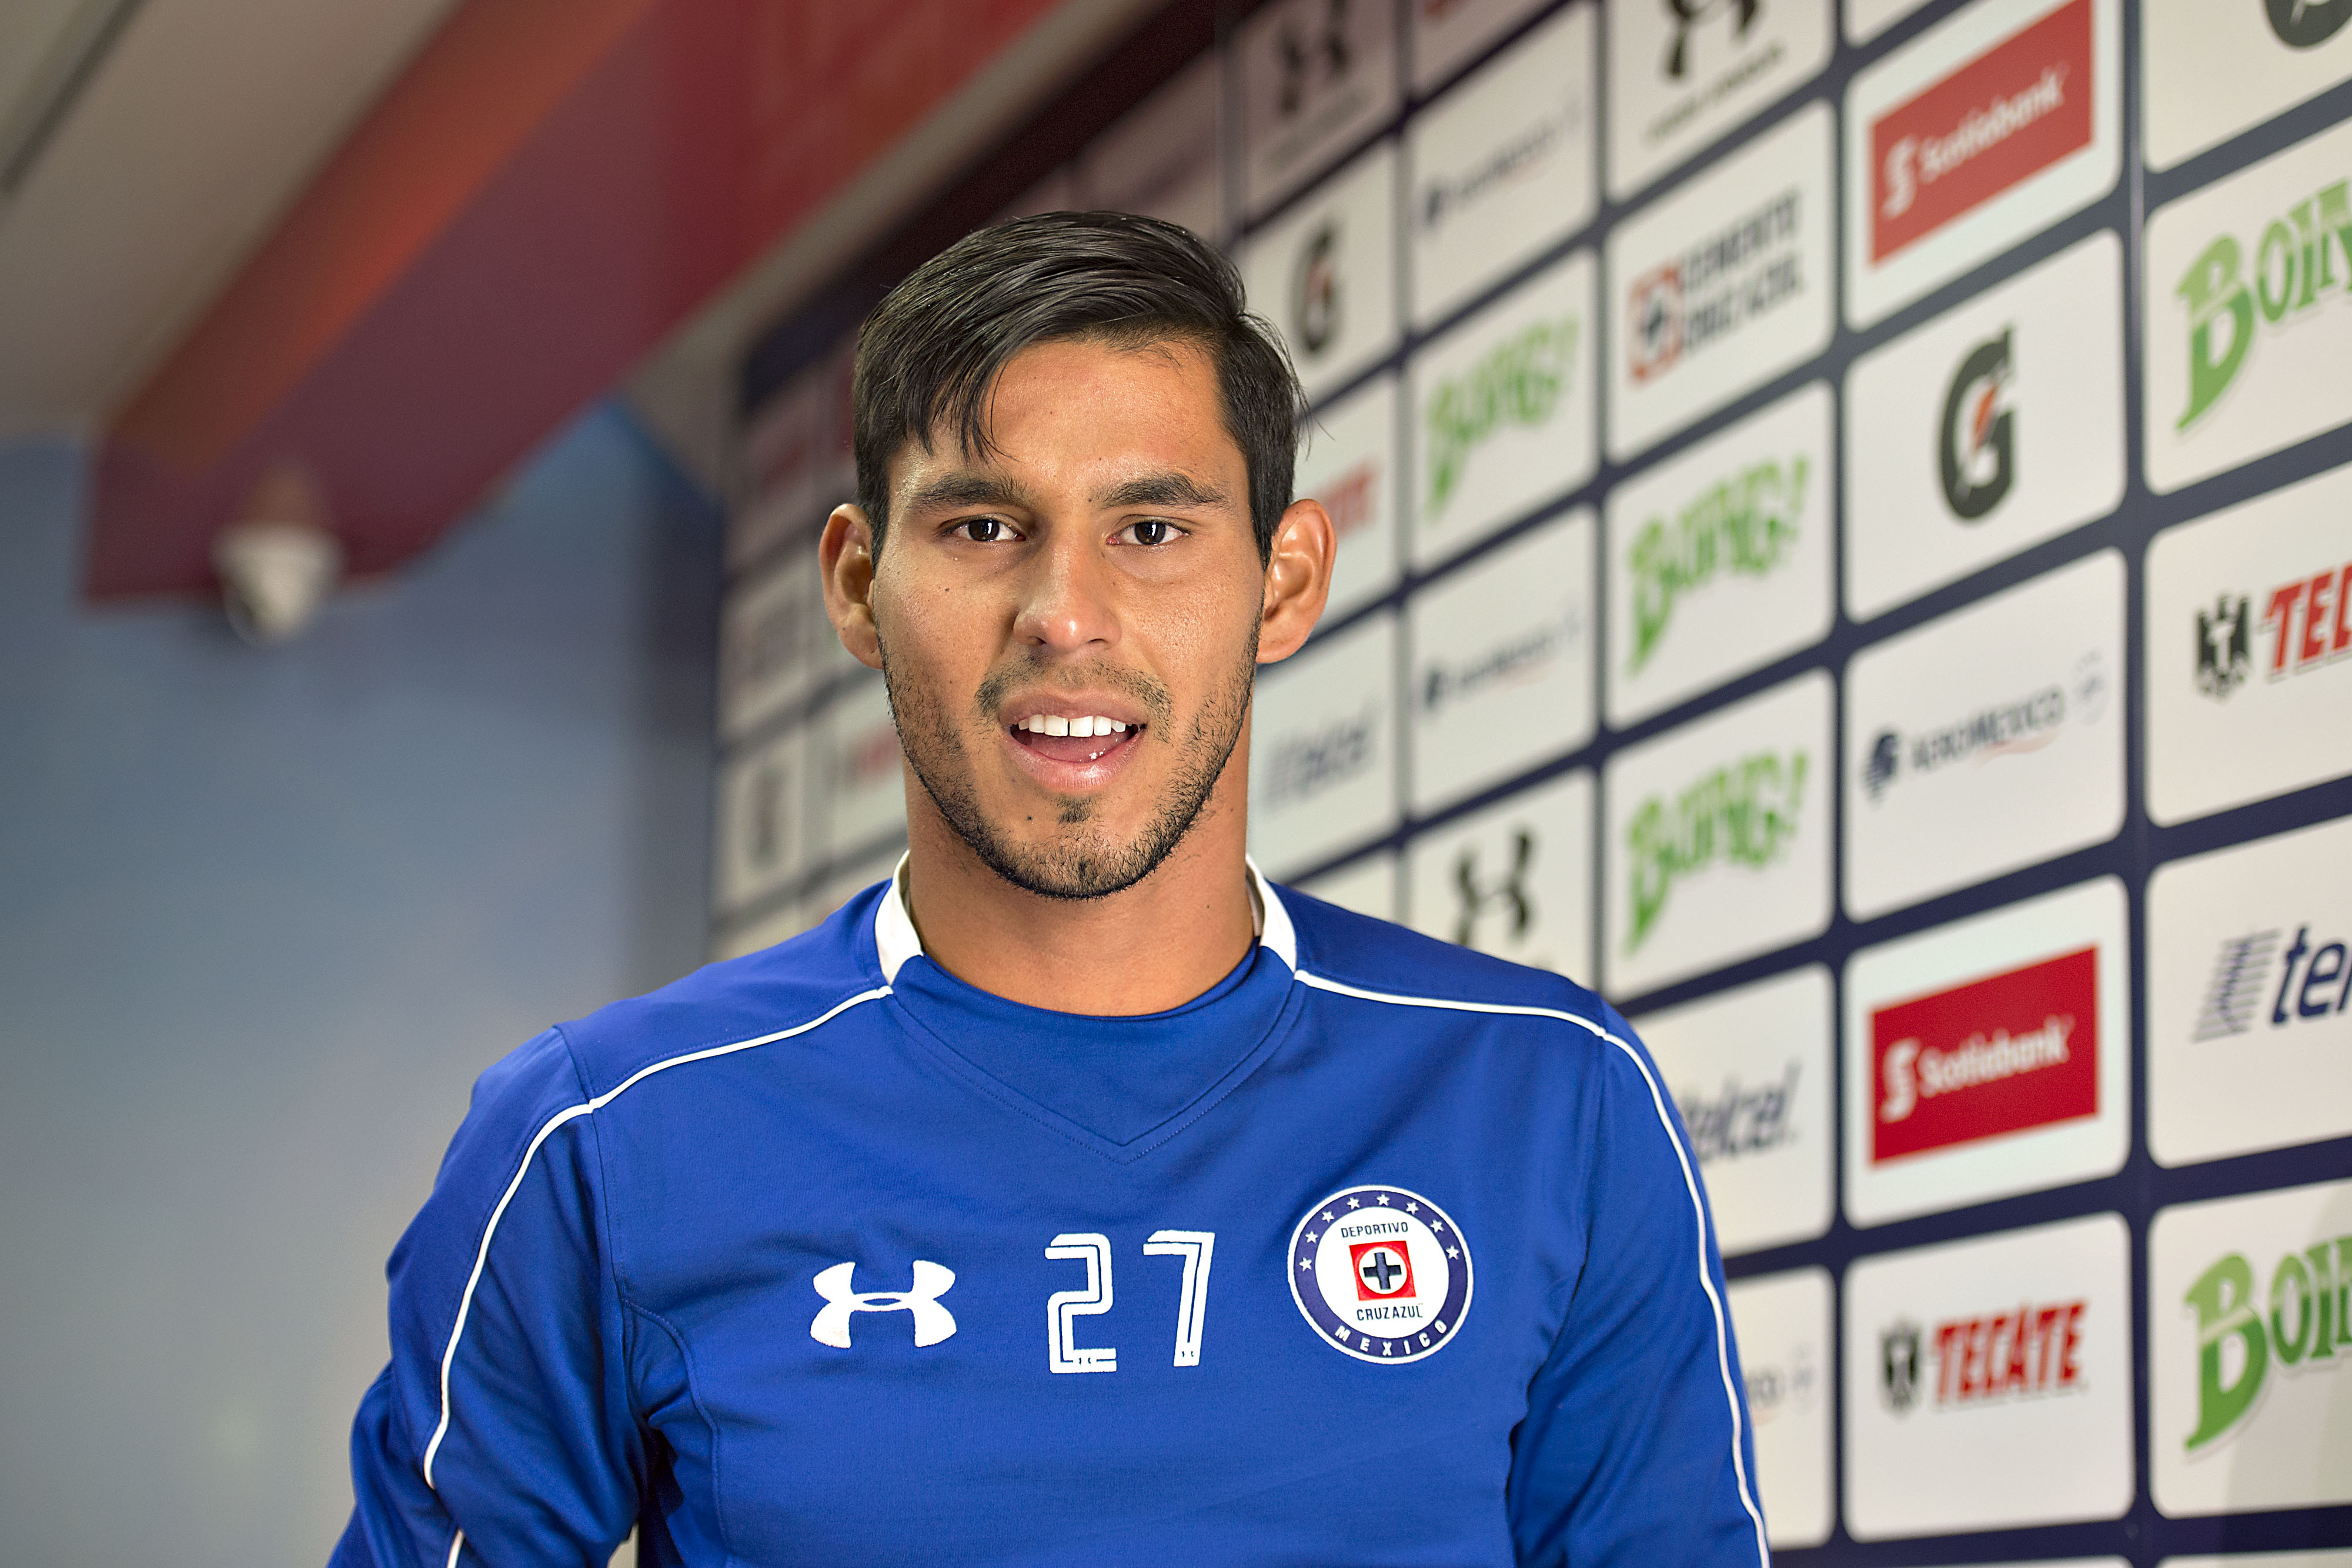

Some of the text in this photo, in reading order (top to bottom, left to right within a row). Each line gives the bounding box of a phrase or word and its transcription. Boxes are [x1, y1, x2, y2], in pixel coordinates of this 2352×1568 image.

[1918, 66, 2066, 185] Scotiabank
[1917, 1016, 2072, 1097] Scotiabank
[1341, 1221, 1409, 1238] DEPORTIVO
[1045, 1230, 1215, 1373] 27
[1334, 1319, 1447, 1356] MEXICO
[1933, 1298, 2087, 1405] TECATE
